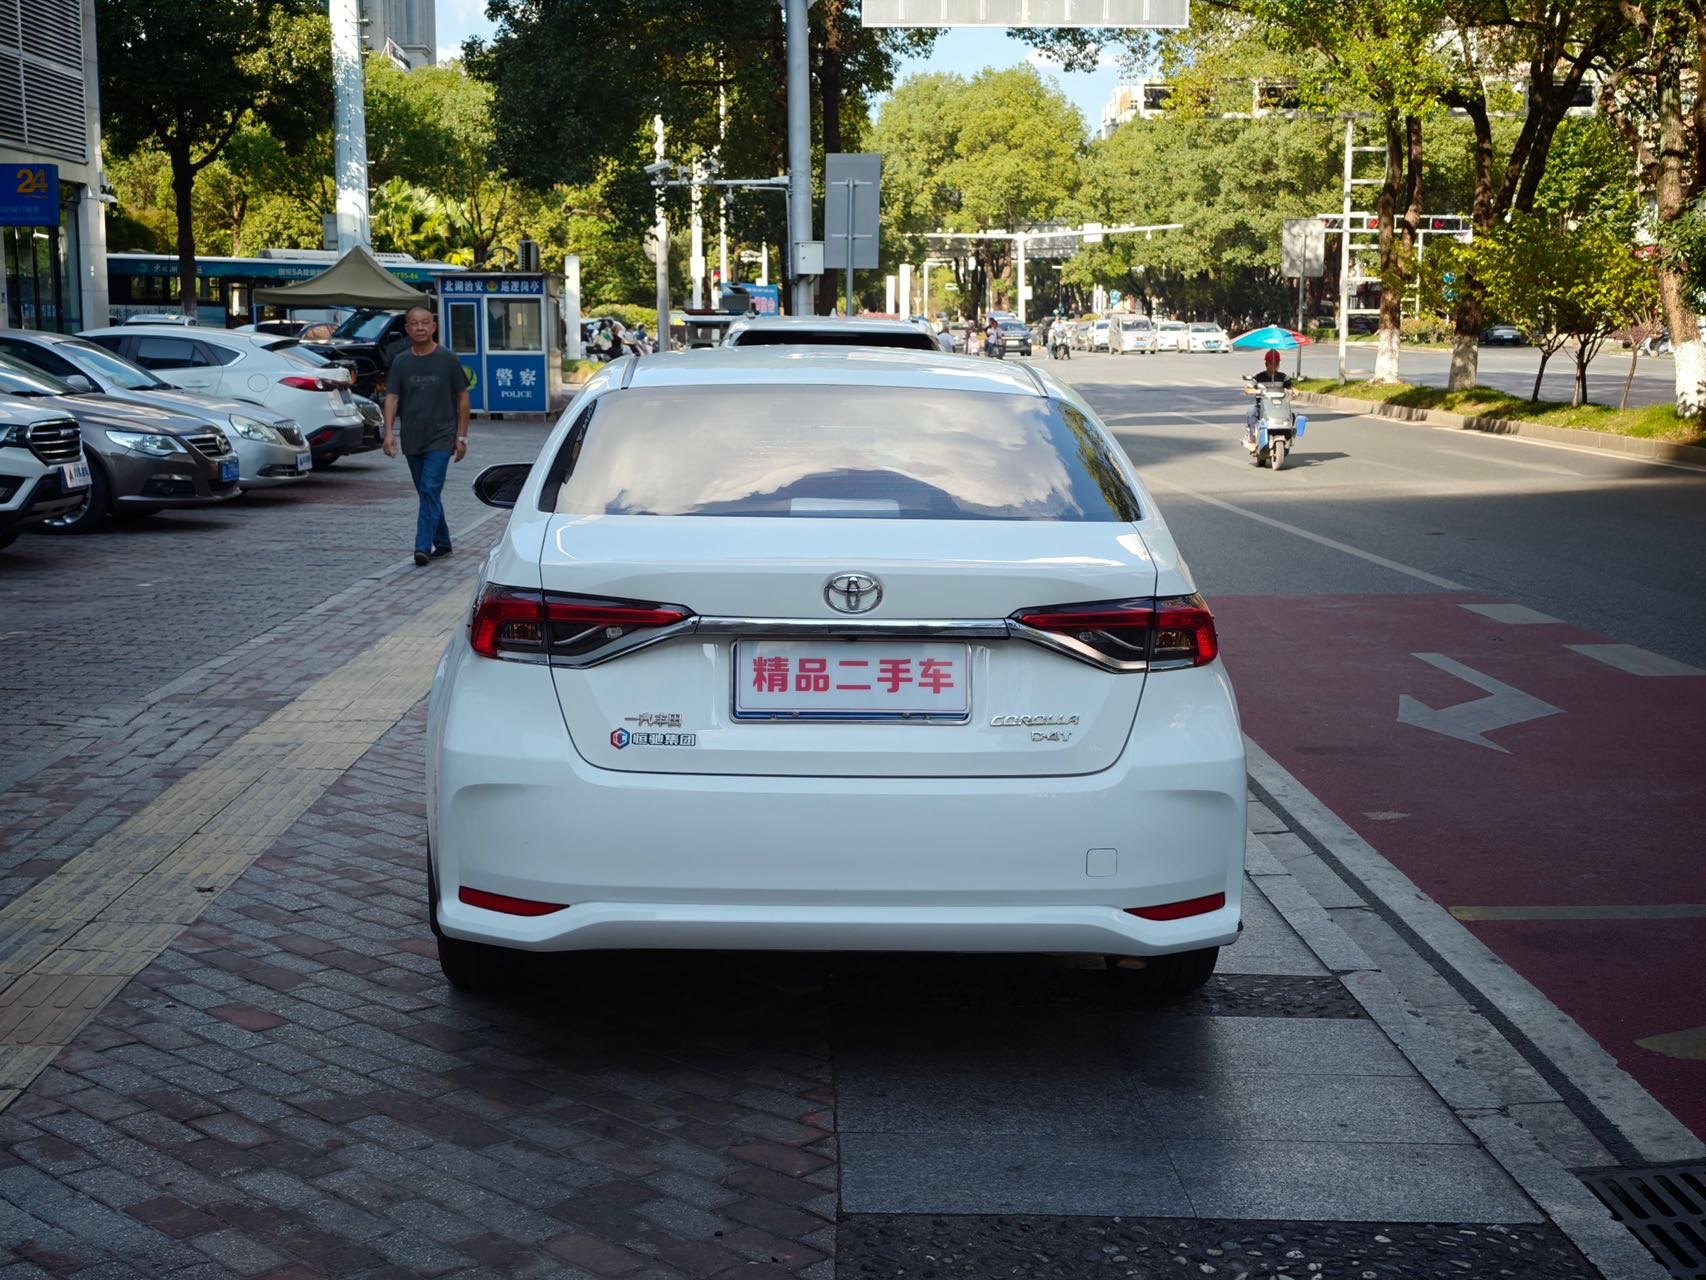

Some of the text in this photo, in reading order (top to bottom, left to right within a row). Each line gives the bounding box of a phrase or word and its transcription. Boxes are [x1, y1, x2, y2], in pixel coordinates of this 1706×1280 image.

[16, 168, 48, 192] 24
[496, 367, 537, 387] 警察
[501, 390, 533, 398] POLICE
[752, 656, 955, 694] 精品二手车
[990, 713, 1080, 727] COROLLA
[632, 732, 696, 746] 恒驰集团
